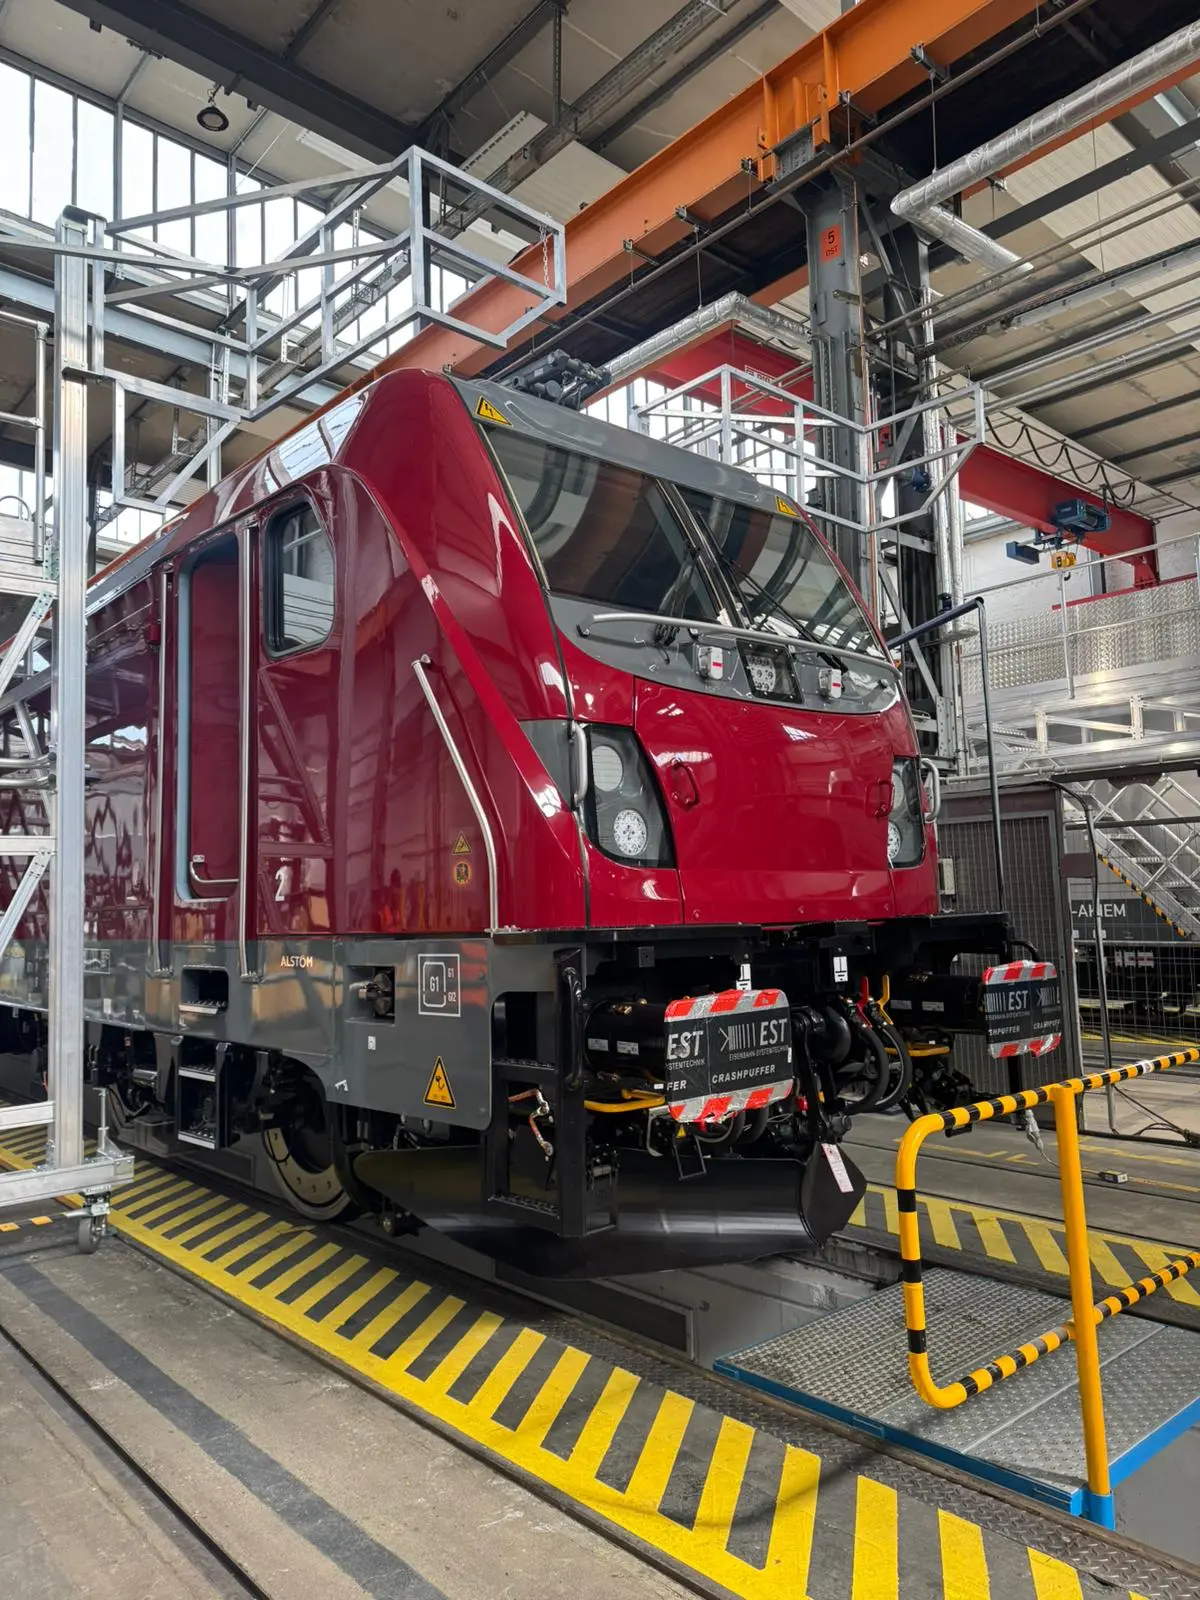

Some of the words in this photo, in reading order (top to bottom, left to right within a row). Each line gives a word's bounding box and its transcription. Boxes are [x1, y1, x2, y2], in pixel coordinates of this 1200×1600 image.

[827, 230, 835, 244] 5
[275, 865, 285, 901] 2
[280, 955, 313, 968] ALSTOM
[429, 975, 439, 992] G1
[1008, 990, 1029, 1010] EST
[760, 1018, 788, 1046] EST
[666, 1030, 704, 1060] EST
[711, 1064, 776, 1084] CRASHPUFFER
[667, 1080, 687, 1091] FER
